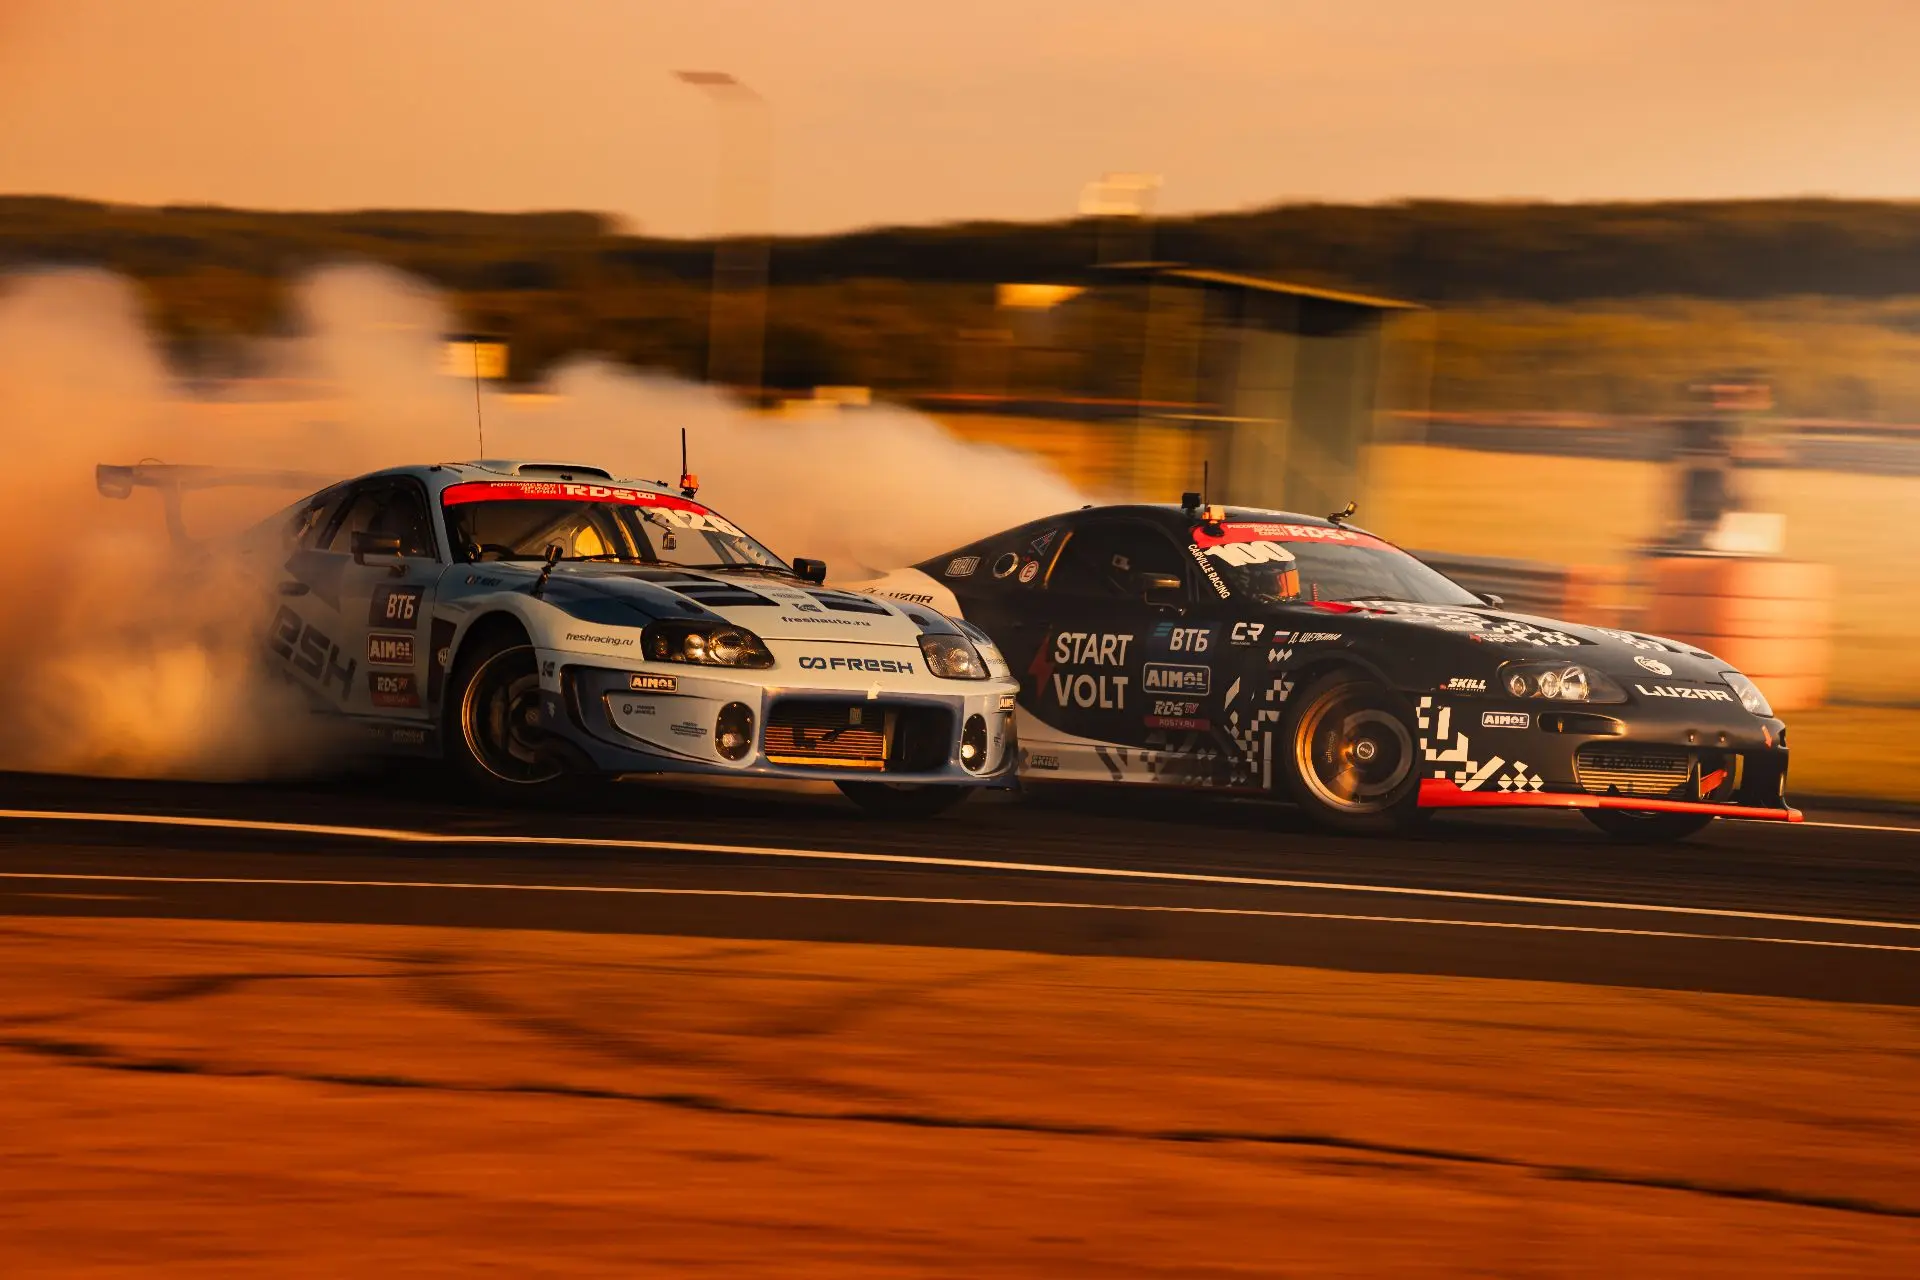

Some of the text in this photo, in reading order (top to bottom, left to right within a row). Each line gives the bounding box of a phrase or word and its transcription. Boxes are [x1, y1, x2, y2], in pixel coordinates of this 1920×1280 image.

[564, 484, 636, 500] RDS
[1284, 525, 1346, 540] RDS
[1203, 541, 1296, 567] 100
[1188, 544, 1230, 599] CARVILLE RACING
[887, 592, 933, 604] UZAR
[781, 616, 871, 627] freshauto.ru
[565, 632, 634, 646] freshracing.ru
[370, 640, 413, 660] AIMOL
[1054, 631, 1134, 666] START
[830, 658, 915, 675] FRESH
[632, 676, 676, 690] AIMOL
[1146, 669, 1206, 690] AIMOL
[1448, 677, 1487, 690] SKILL
[1053, 673, 1129, 709] VOLT
[1635, 684, 1734, 702] LUZAR
[1154, 700, 1184, 716] RDS
[1484, 714, 1528, 726] AIMOL
